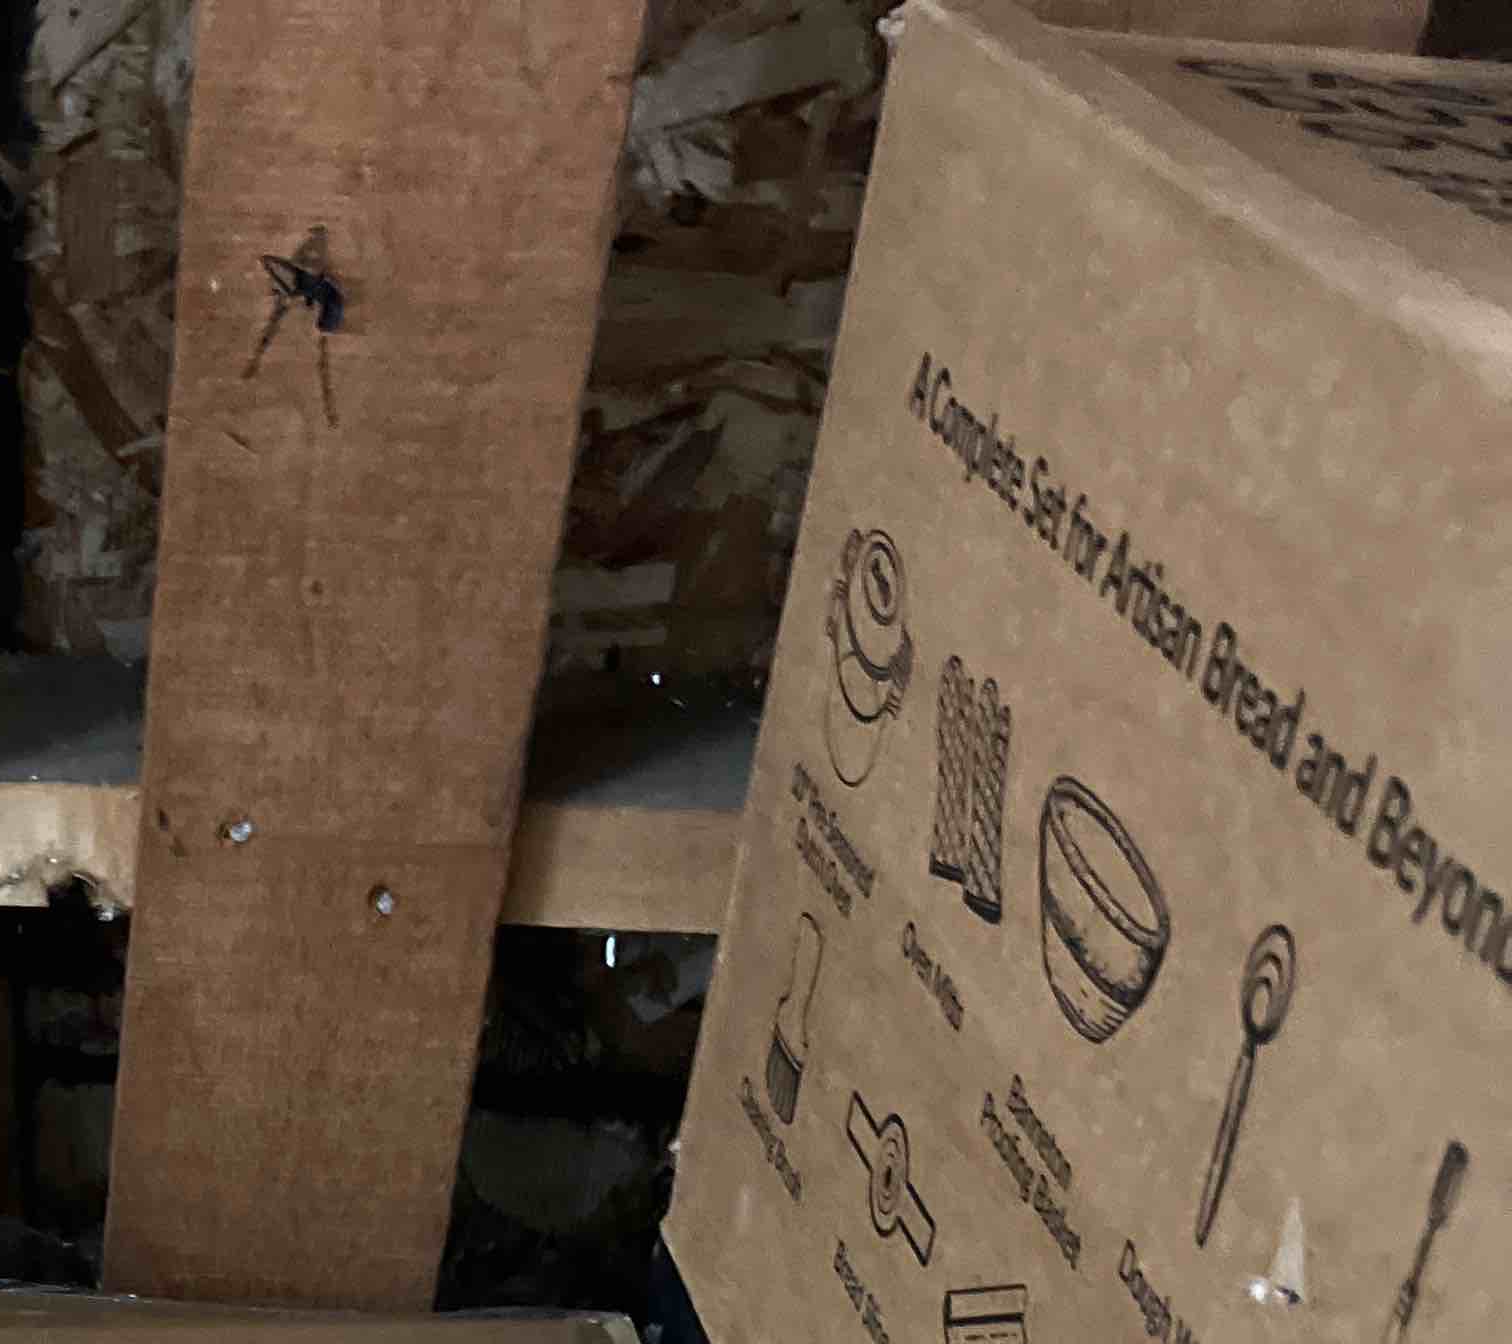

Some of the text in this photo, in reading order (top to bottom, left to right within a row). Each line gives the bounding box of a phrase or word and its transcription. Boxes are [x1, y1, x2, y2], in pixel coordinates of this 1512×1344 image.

[909, 351, 931, 421] A
[930, 367, 1025, 511] Complete
[1023, 455, 1067, 550] Set
[1064, 493, 1107, 581] for
[1100, 530, 1202, 680] Artisan
[1201, 621, 1306, 770] Bread
[1296, 733, 1378, 836] and
